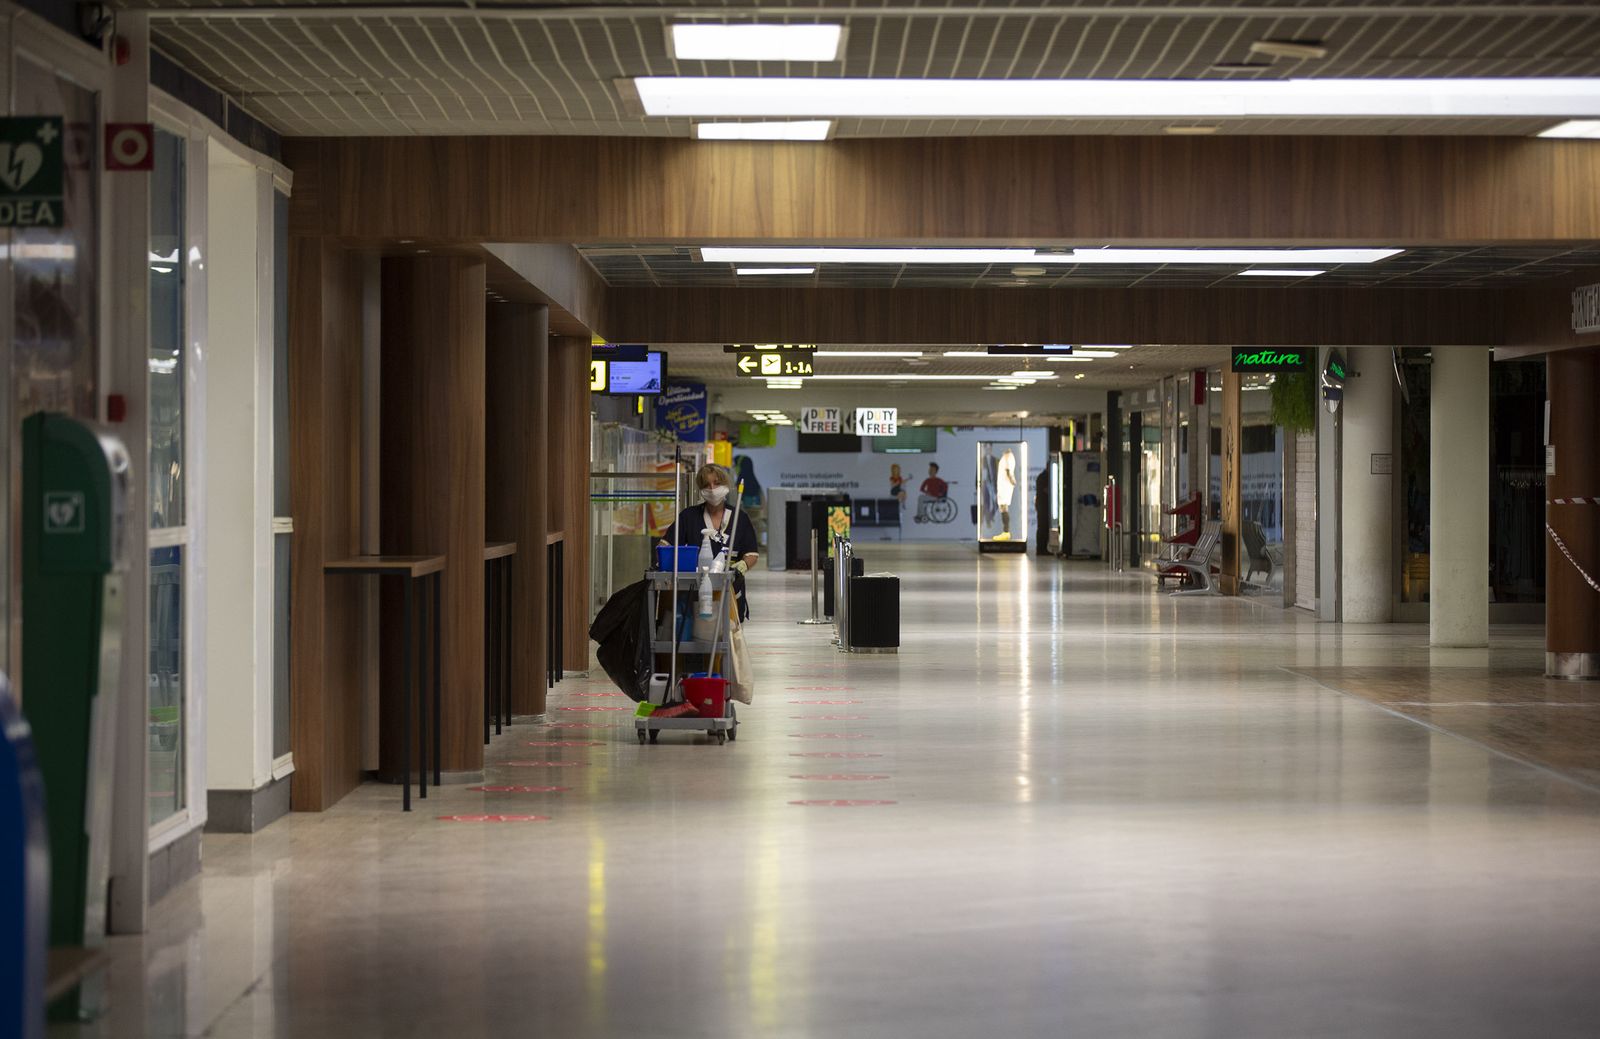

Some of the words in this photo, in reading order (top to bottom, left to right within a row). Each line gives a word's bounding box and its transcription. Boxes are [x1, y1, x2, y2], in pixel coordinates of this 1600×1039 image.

[0, 201, 56, 224] DEA
[1234, 350, 1303, 366] natura
[785, 361, 813, 374] 1-1A
[810, 408, 838, 419] DUTY
[867, 410, 894, 421] DUTY
[811, 421, 838, 432] FREE
[867, 423, 894, 434] FREE
